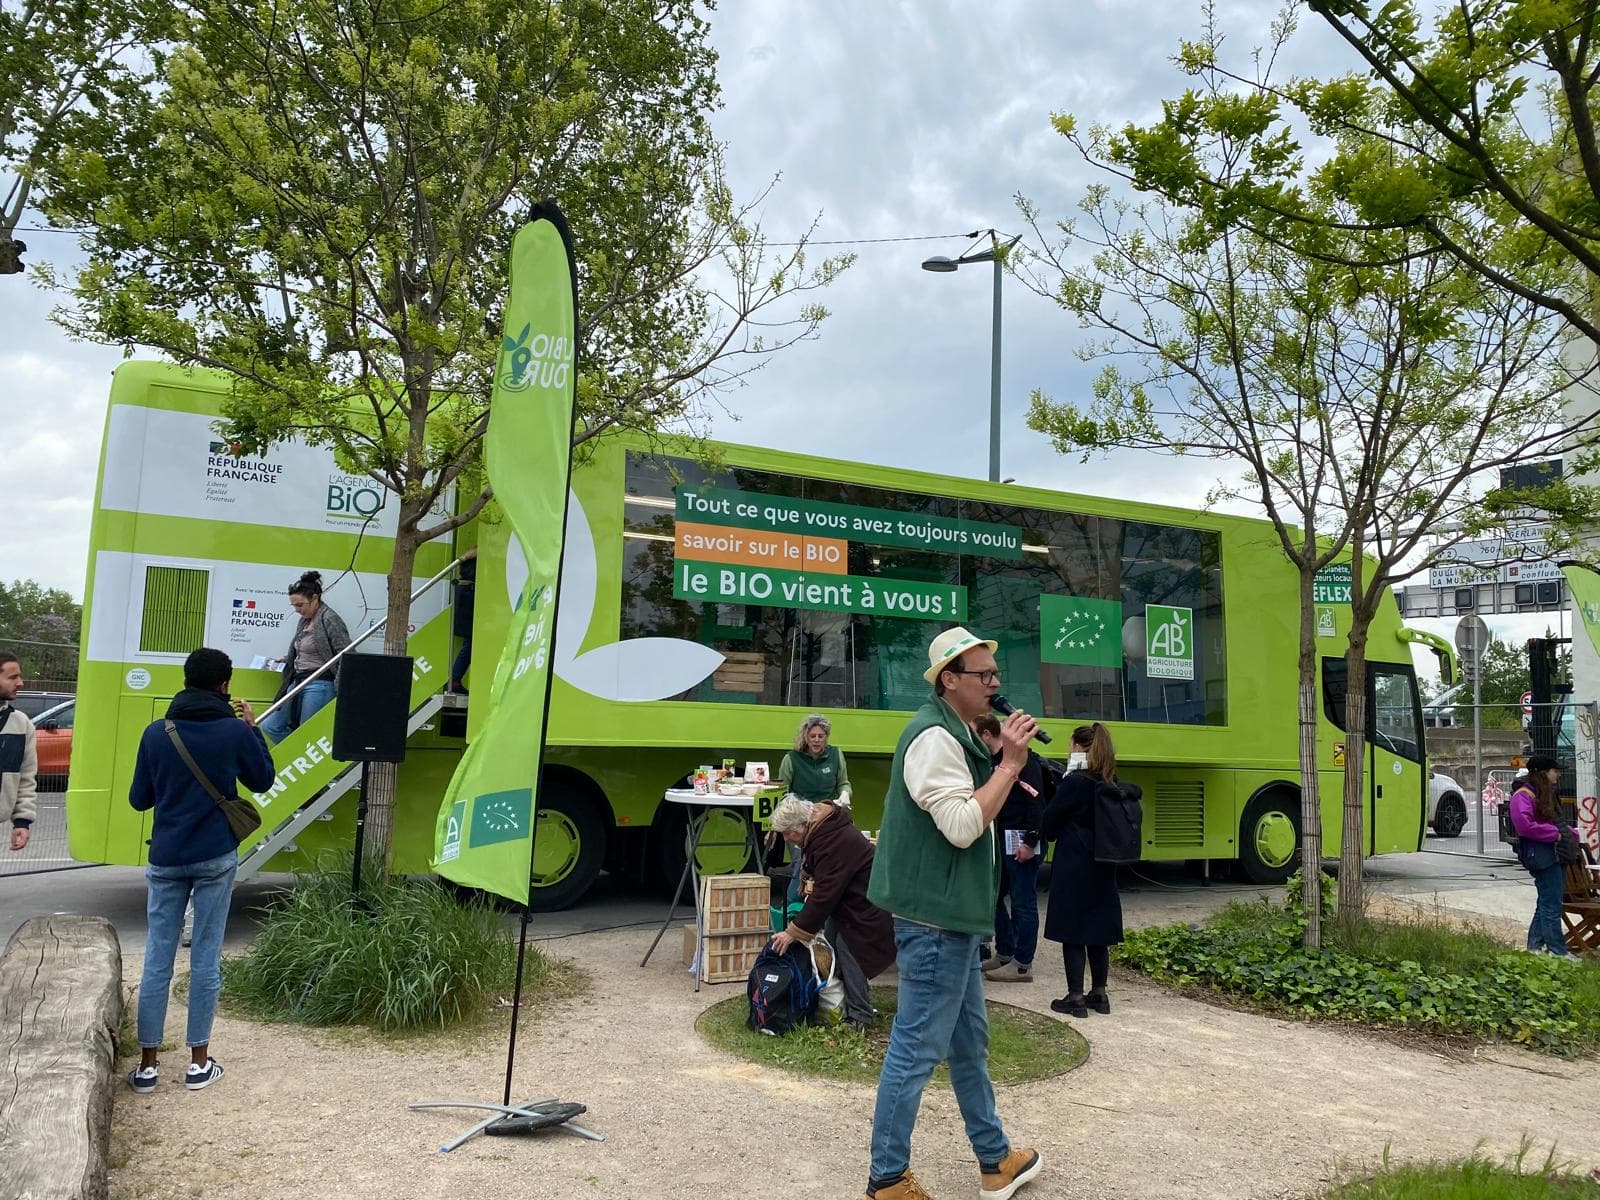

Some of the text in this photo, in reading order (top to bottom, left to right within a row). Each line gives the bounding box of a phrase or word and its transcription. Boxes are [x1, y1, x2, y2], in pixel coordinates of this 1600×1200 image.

[208, 455, 283, 473] RÉPUBLIQUE
[207, 467, 277, 483] FRANÇAISE
[683, 492, 1017, 549] Tout ce que vous avez toujours voulu
[682, 533, 841, 563] savoir sur le BIO
[1333, 574, 1353, 582] locau
[1521, 570, 1561, 579] confluen
[682, 564, 958, 615] le BIO vient à vous !
[1313, 582, 1353, 602] ÉFLEX
[231, 610, 285, 621] RÉPUBLIQUE
[231, 618, 280, 628] FRANÇAISE
[1151, 622, 1185, 656] AB
[1148, 659, 1192, 668] AGRICULTURE
[1148, 667, 1192, 677] BIOLOGIQUE
[252, 736, 333, 809] ENTRÉE
